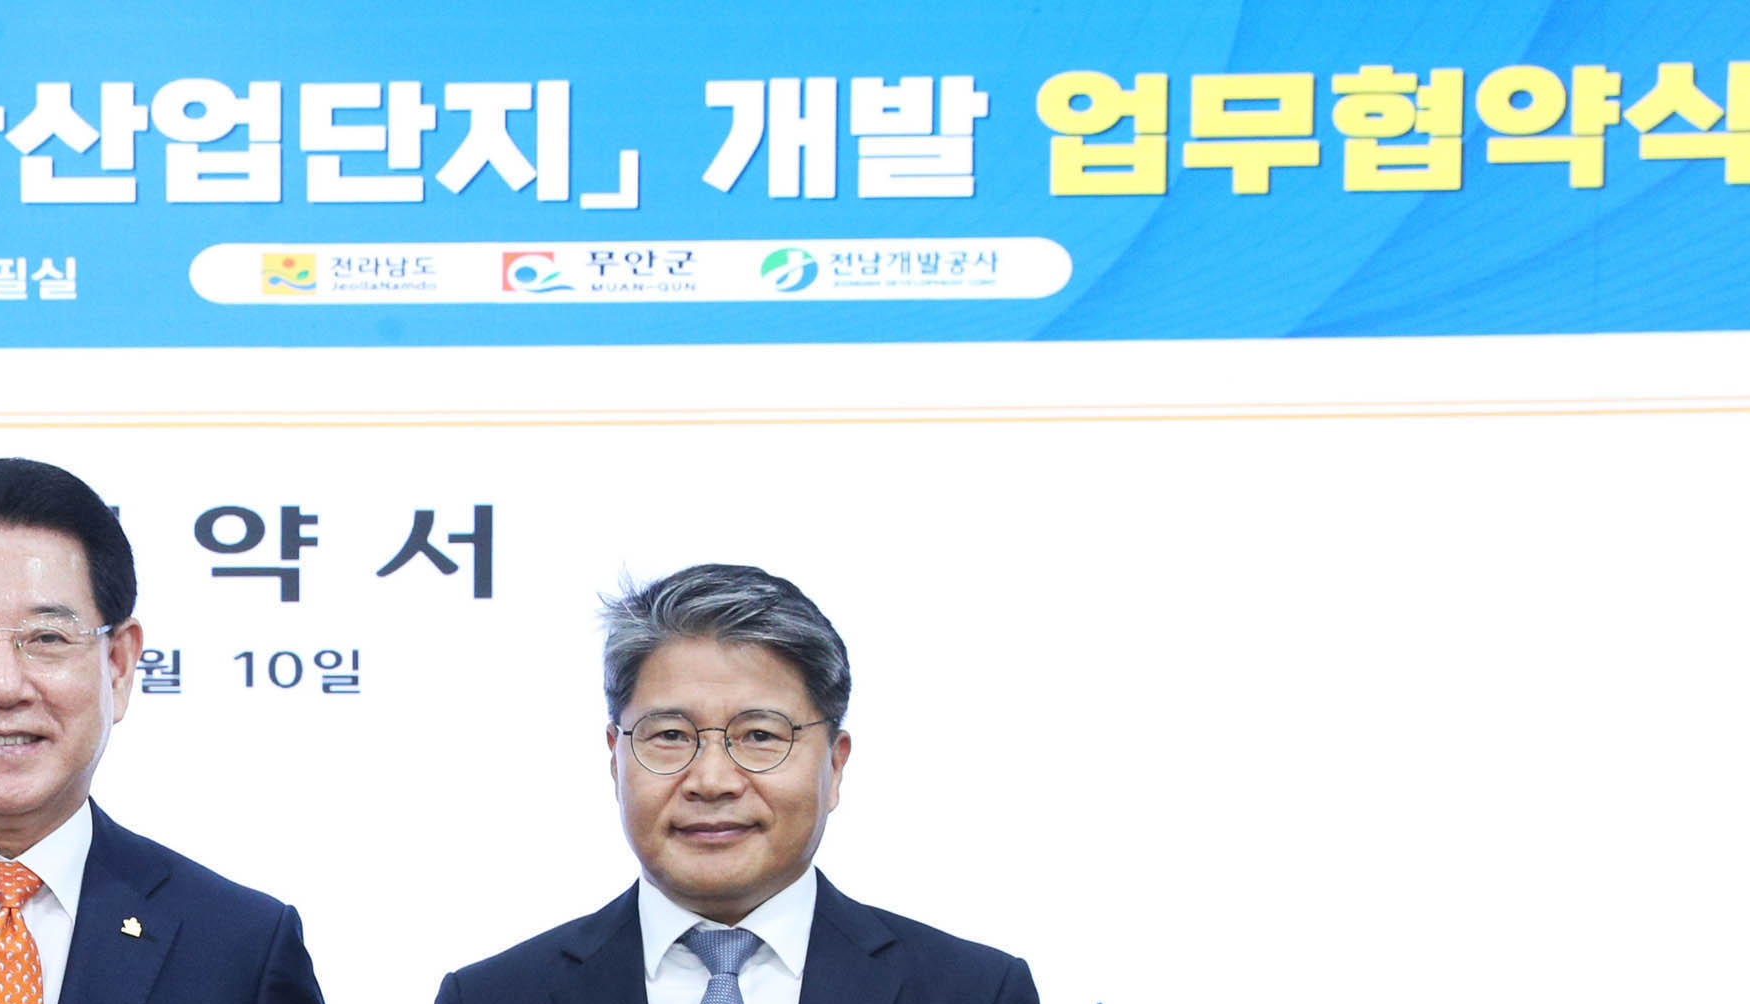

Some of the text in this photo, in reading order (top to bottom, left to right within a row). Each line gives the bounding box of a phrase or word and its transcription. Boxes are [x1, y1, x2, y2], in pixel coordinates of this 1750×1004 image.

[702, 75, 989, 199] 개발
[1036, 60, 1750, 196] 업무협약식
[330, 255, 438, 278] 전라남도
[586, 249, 698, 277] 무안군
[830, 250, 999, 276] 전남개발공사
[233, 649, 361, 694] 10일
